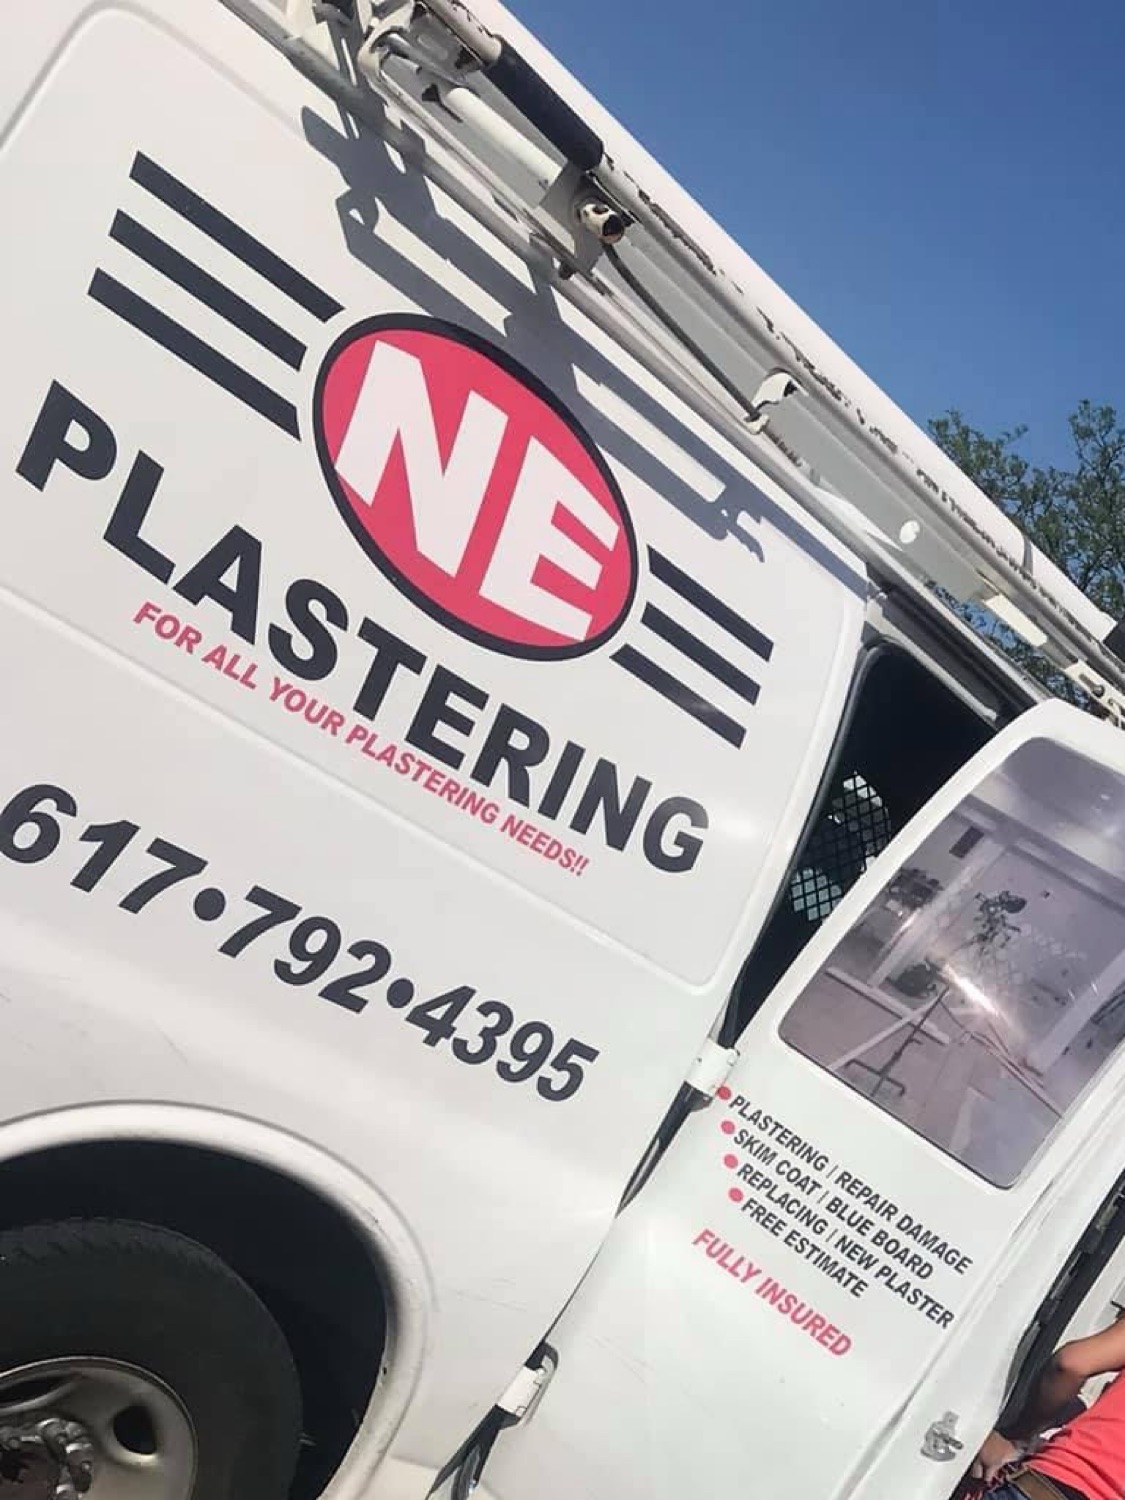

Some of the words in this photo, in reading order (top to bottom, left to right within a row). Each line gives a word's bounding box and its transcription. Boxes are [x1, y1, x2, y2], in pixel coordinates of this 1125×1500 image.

[334, 340, 620, 642] NE
[16, 379, 709, 873] PLASTERING
[133, 602, 203, 654] FOR
[202, 645, 257, 689] ALL
[270, 676, 345, 738] YOUR
[346, 725, 499, 825] PLASTERING
[501, 816, 590, 877] NEEDS!!
[729, 1095, 831, 1173] PLASTERING
[834, 1171, 899, 1223] REPAIR
[899, 1214, 973, 1275] DAMAGE
[733, 1128, 777, 1166] SKIM
[775, 1160, 823, 1197] COAT
[826, 1197, 875, 1236] BLUE
[871, 1229, 935, 1281] BOARD
[736, 1163, 829, 1235] REPLACING
[835, 1234, 881, 1271] NEW
[876, 1265, 955, 1330] PLASTER
[740, 1197, 786, 1236] FREE
[783, 1230, 870, 1300] ESTIMATE
[693, 1228, 763, 1284] FULLY
[755, 1277, 852, 1357] INSURED
